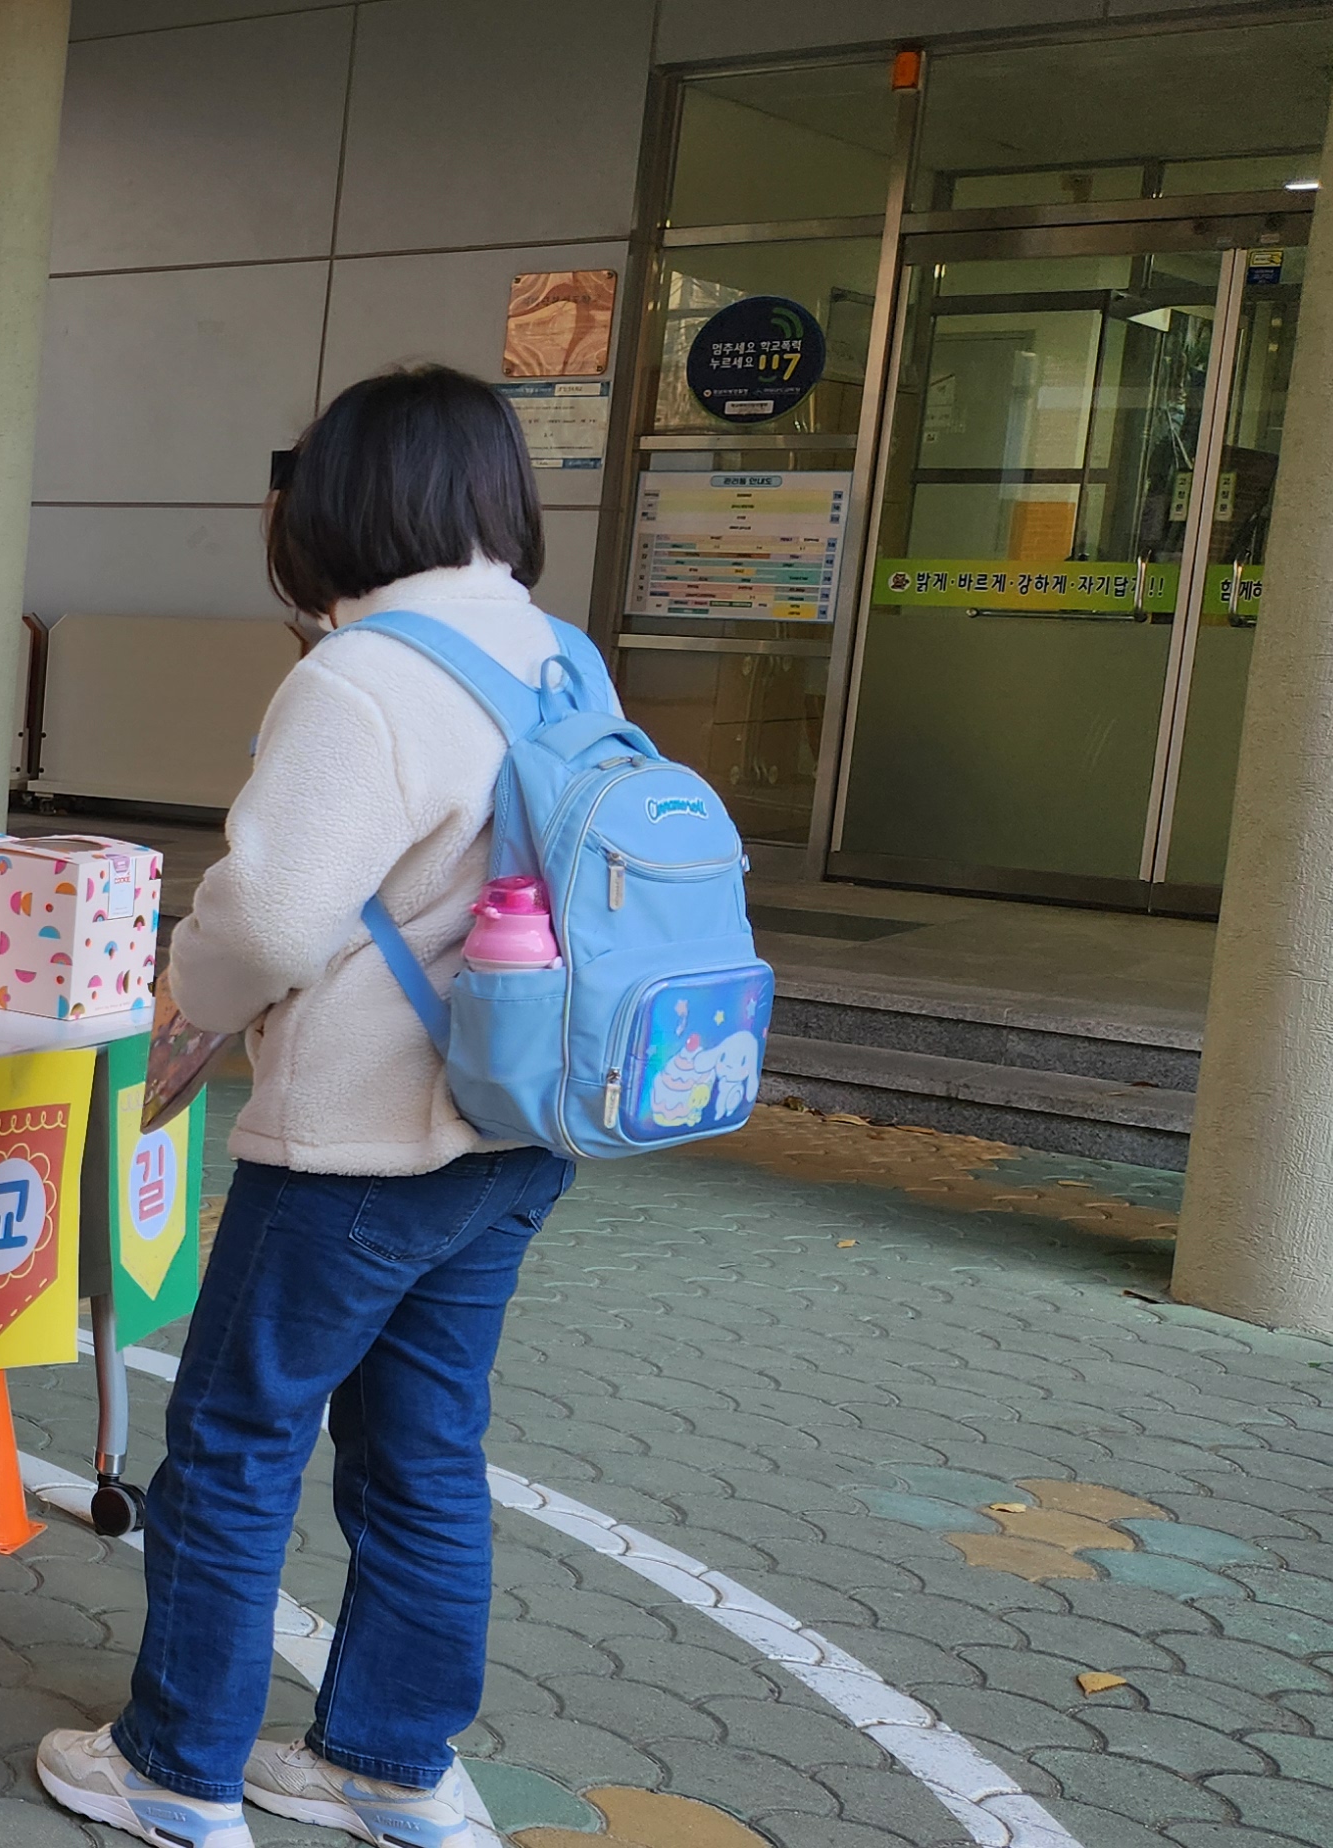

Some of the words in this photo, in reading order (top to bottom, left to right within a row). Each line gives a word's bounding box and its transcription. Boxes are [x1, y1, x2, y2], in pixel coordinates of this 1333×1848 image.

[712, 342, 756, 355] 멈추세요
[760, 340, 802, 352] 학교폭력
[709, 356, 754, 371] 누르세요
[757, 353, 801, 381] 117
[136, 1144, 164, 1221] 길
